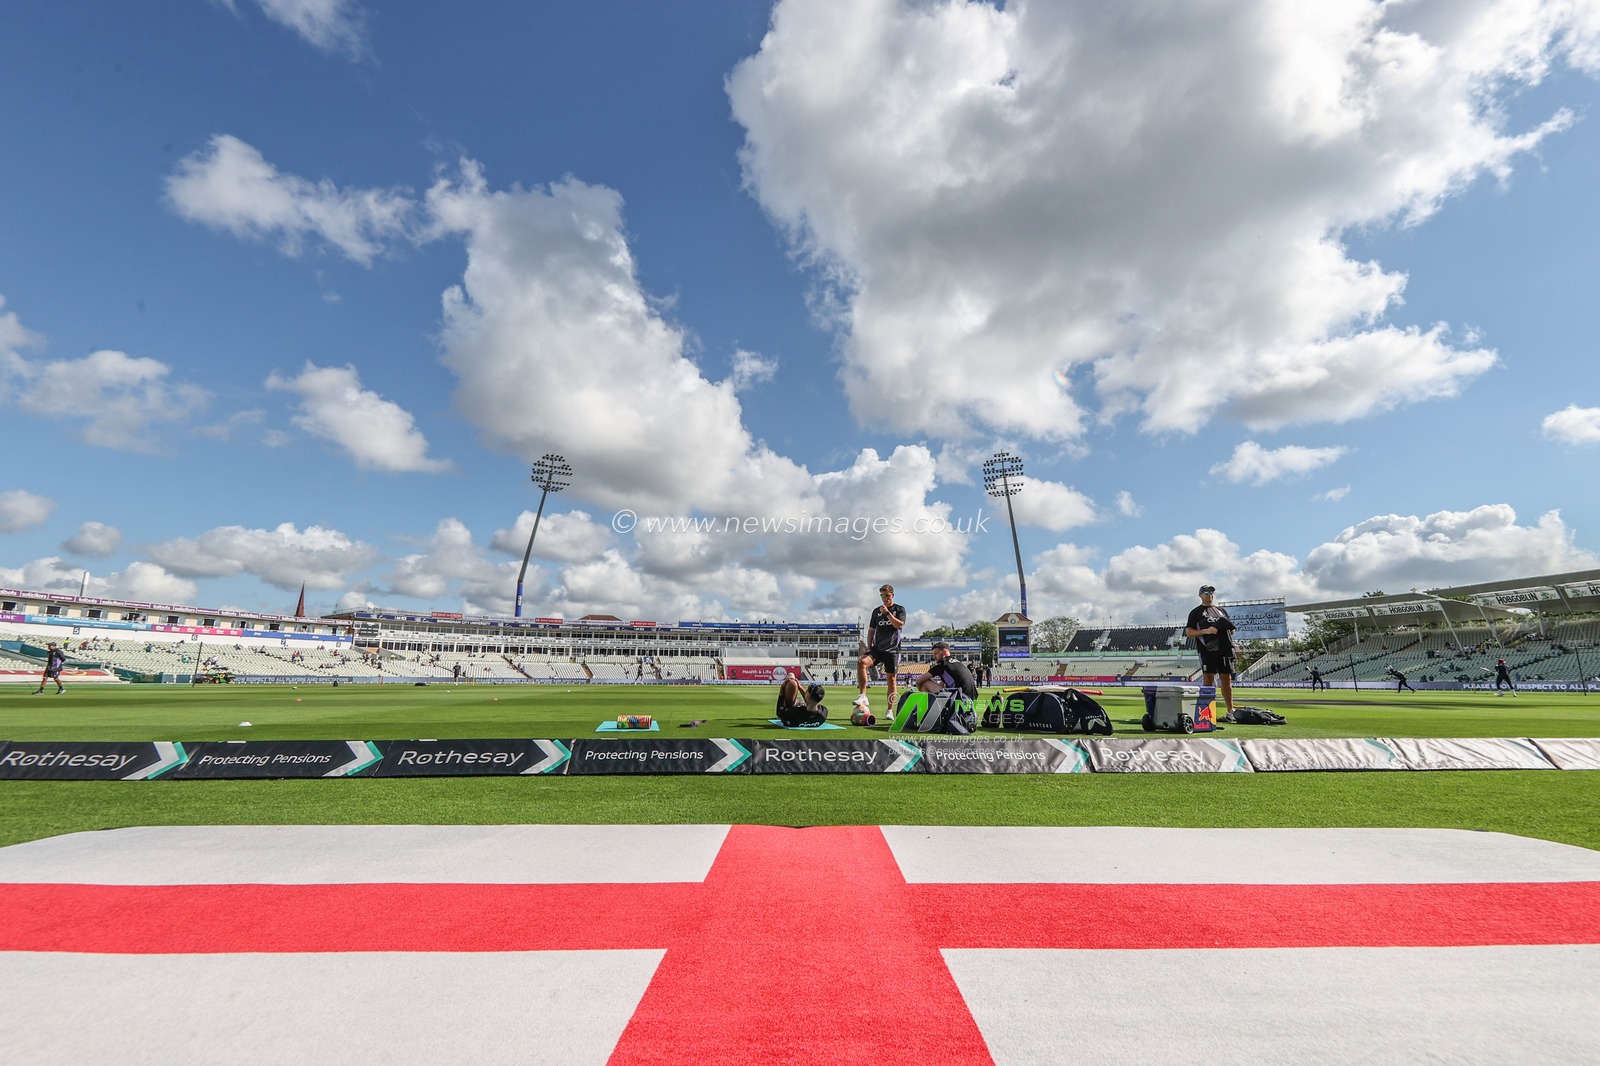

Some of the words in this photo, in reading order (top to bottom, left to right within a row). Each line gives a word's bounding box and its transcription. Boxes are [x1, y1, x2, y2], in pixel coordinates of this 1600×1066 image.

[1496, 592, 1538, 605] HOBGOBLIN
[1324, 611, 1354, 619] HOBGOBLIN
[1389, 604, 1424, 614] HOBGOBLIN
[74, 627, 79, 635] 5
[0, 750, 138, 771] Rothesay
[199, 754, 270, 767] Protecting
[271, 753, 332, 764] Pensions
[398, 750, 525, 767] Rothesay
[585, 750, 648, 762] Protecting
[650, 750, 704, 760] Pensions
[765, 748, 877, 765] Rothesay
[936, 750, 994, 762] Protecting
[997, 749, 1046, 760] Pensions
[1098, 747, 1204, 765] Rothesay
